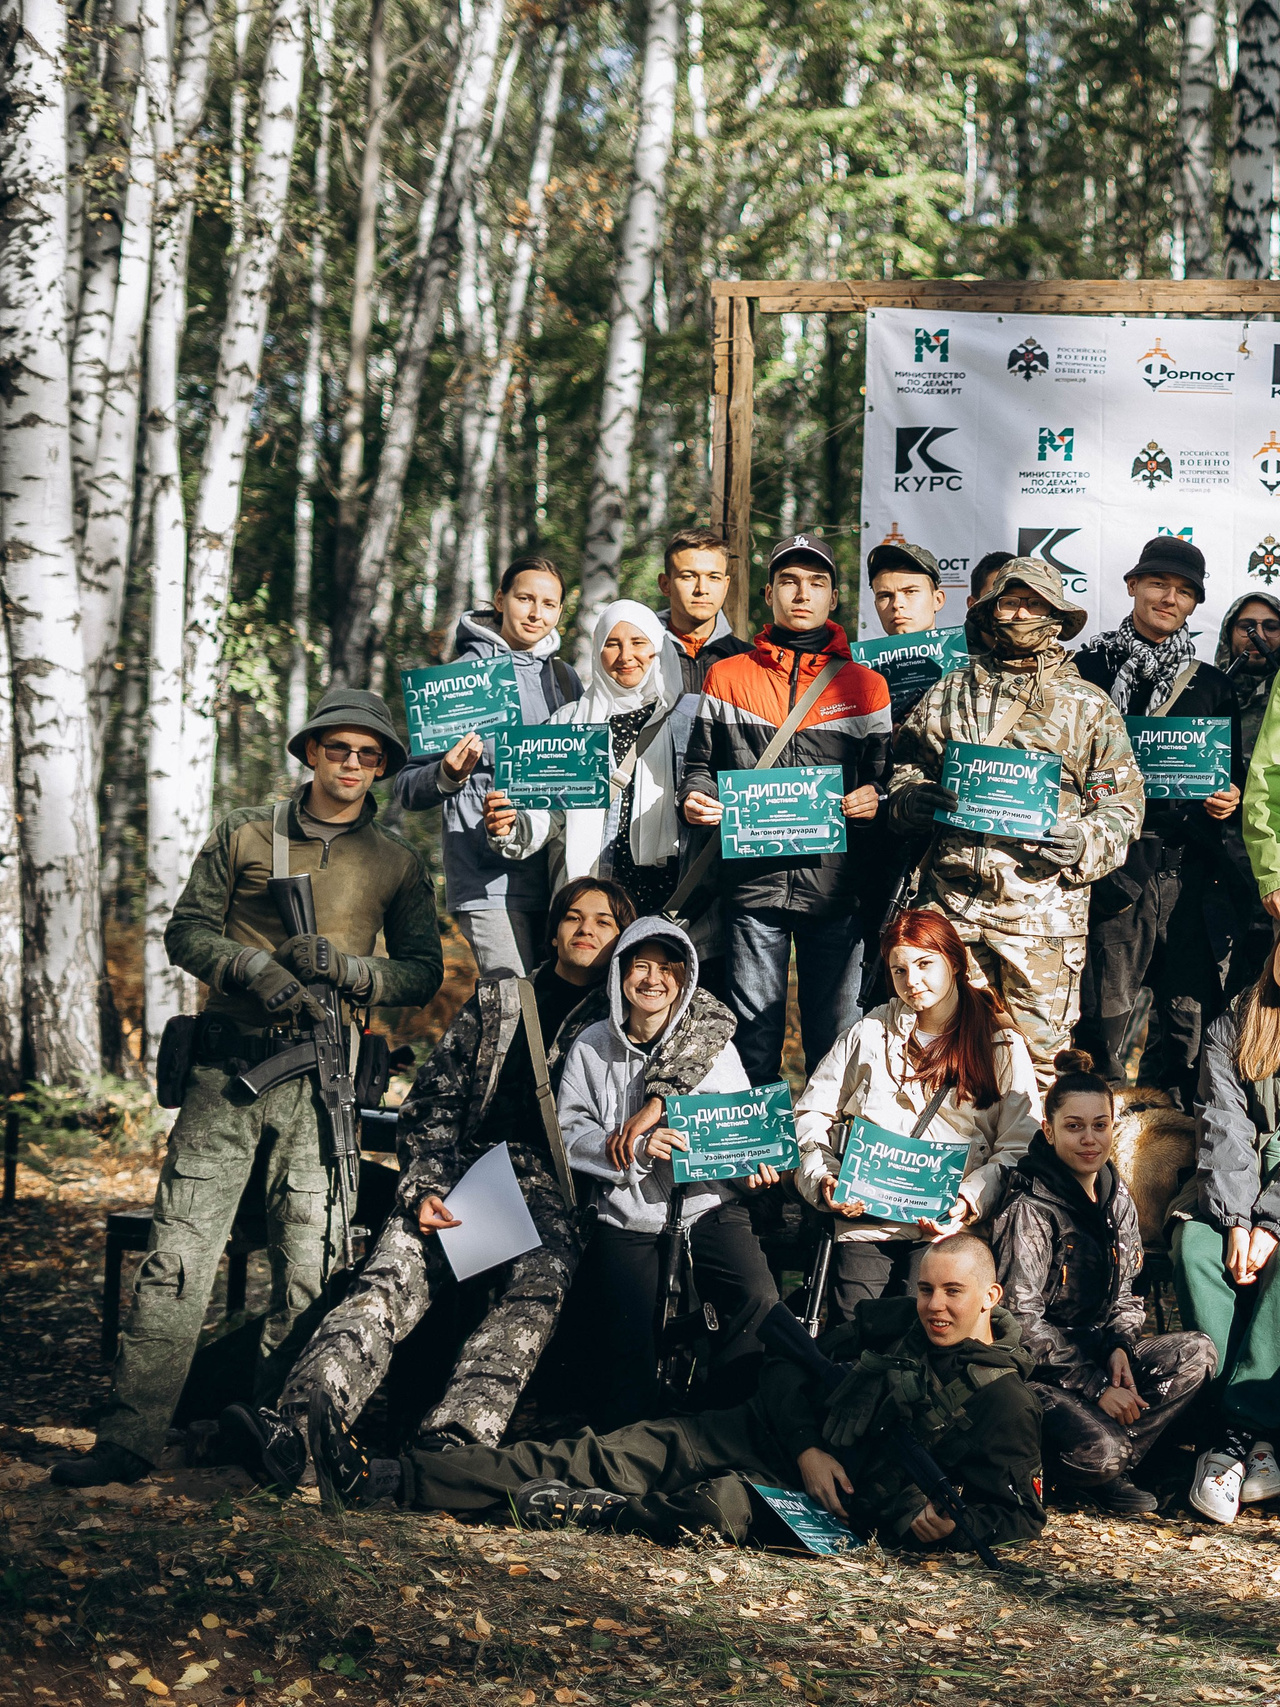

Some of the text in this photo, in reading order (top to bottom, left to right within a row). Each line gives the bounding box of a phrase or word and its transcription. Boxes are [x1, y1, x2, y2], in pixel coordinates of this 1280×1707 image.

[1057, 346, 1107, 354] РОССИЙСКОЕ
[1056, 354, 1107, 362] ВОЕННО
[894, 371, 966, 380] МИНИСТЕРСТВО
[1055, 367, 1106, 375] ОБЩЕСТВО
[922, 379, 953, 387] ДЕЛАМ
[897, 387, 962, 395] МОЛОДЕЖИ РТ
[1179, 459, 1230, 467] ВОЕННО
[1018, 471, 1091, 479] МИНИСТЕРСТВО
[893, 475, 963, 493] КУРС
[1046, 479, 1077, 487] ДЕЛАМ
[1179, 477, 1230, 485] ОБЩЕСТВО
[1021, 487, 1073, 495] МОЛОДЕЖИ
[792, 535, 809, 546] LA
[878, 642, 942, 665] ДИПЛОМ
[896, 658, 926, 669] участника
[424, 672, 491, 697] ДИПЛОМ
[442, 690, 474, 701] участника
[1139, 730, 1206, 745] ДИПЛОМ
[520, 737, 586, 754] ДИПЛОМ
[970, 759, 1038, 780] ДИПЛОМ
[986, 775, 1018, 785] участника
[747, 782, 817, 800] ДИПЛОМ
[765, 797, 798, 805] участника
[786, 827, 818, 836] Эдуарду
[696, 1101, 767, 1124] ДИПЛОМ
[715, 1119, 749, 1129] участника
[747, 1148, 771, 1158] Дарье
[871, 1141, 942, 1169] ДИПЛОМ
[887, 1161, 920, 1174] участника
[903, 1198, 928, 1207] Амине
